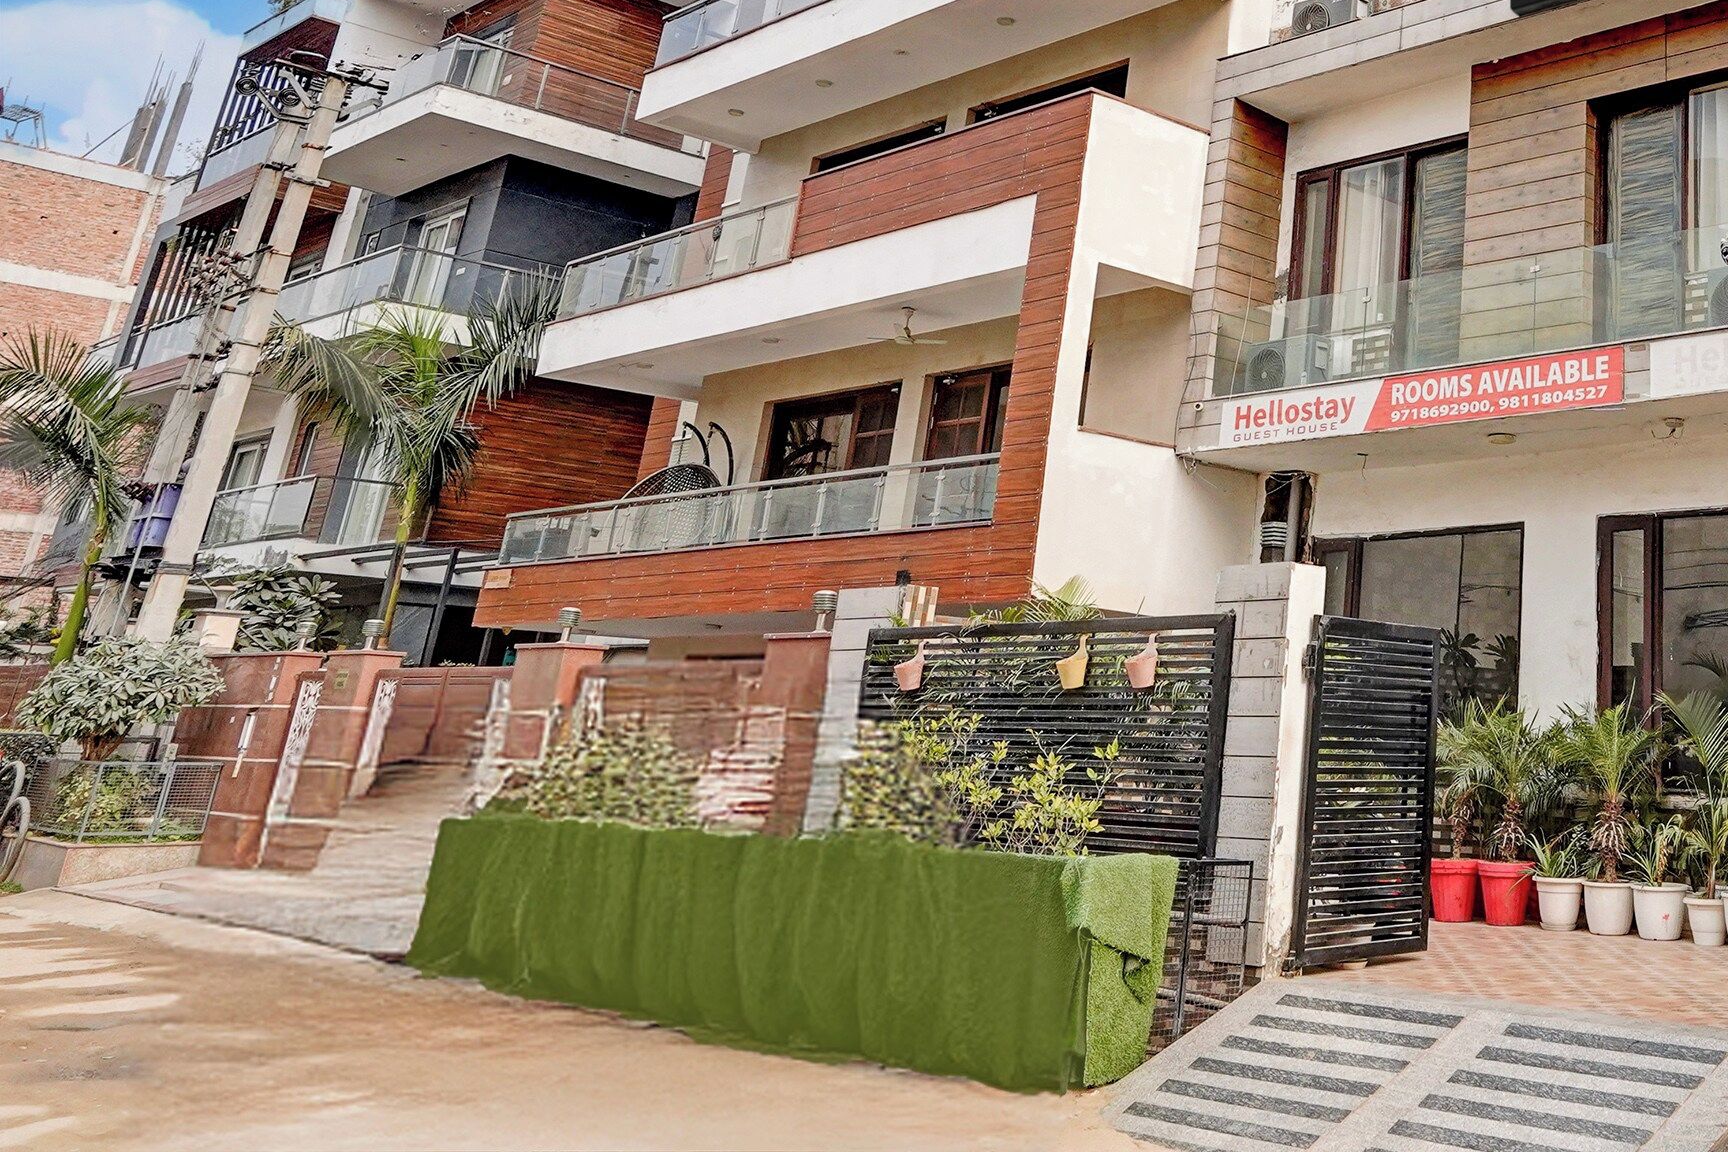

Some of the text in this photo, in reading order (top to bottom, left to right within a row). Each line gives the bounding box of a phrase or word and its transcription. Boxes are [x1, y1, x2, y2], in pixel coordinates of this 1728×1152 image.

[1391, 355, 1609, 405] ROOMS AVAILABLE
[1235, 396, 1356, 430] Hellostay
[1390, 386, 1608, 422] 9718692900, 9811804527
[1234, 422, 1338, 442] GUEST HOUSE
